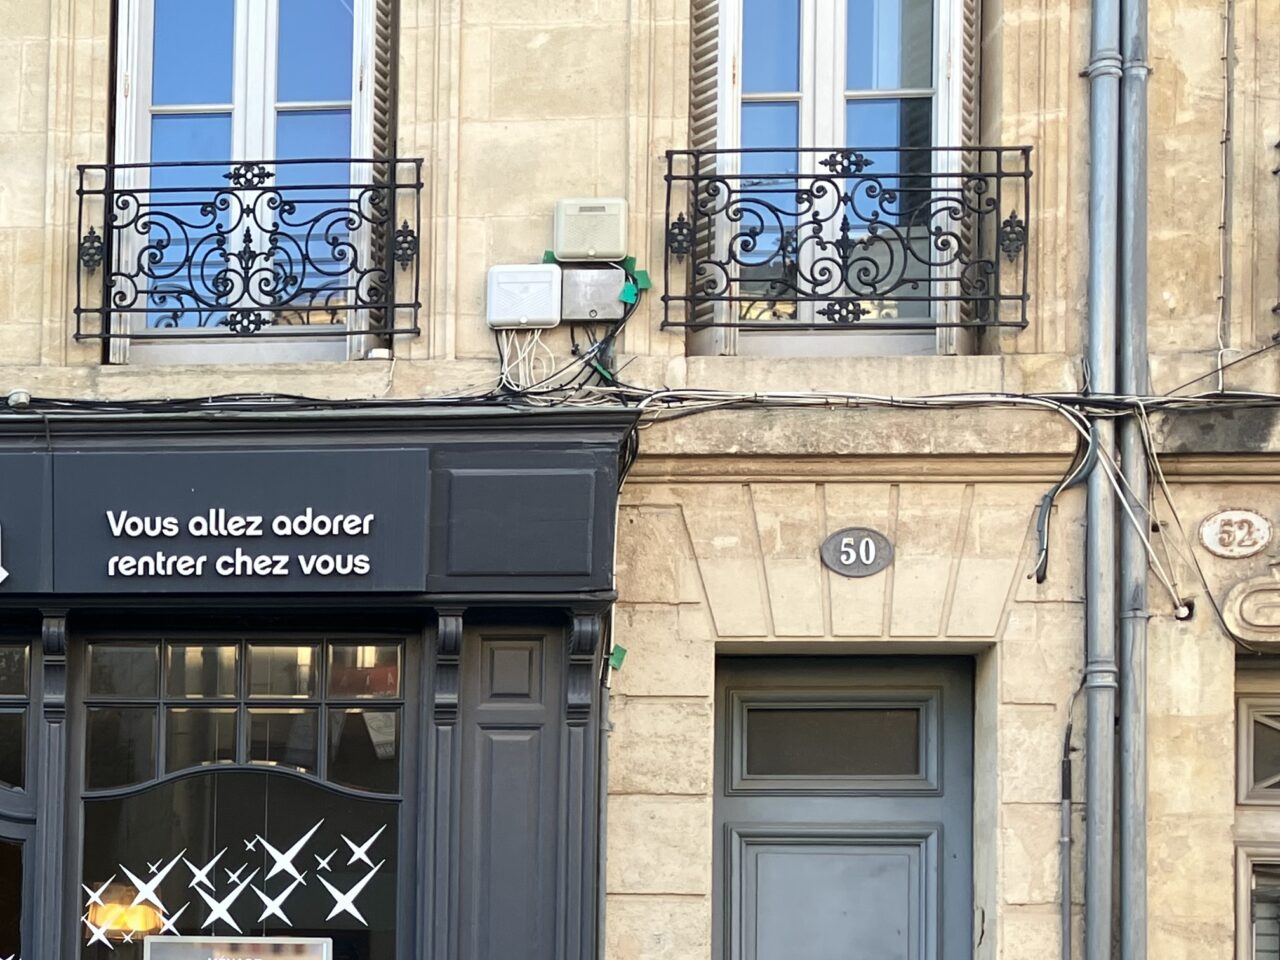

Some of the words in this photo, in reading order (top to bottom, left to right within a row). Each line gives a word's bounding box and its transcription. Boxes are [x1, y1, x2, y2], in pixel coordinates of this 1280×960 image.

[106, 510, 179, 537] Vous
[188, 508, 263, 537] allez
[272, 507, 375, 536] adorer
[1218, 518, 1258, 548] 52
[108, 551, 207, 576] rentrer
[215, 547, 290, 576] chez
[298, 554, 371, 576] vous
[840, 537, 876, 565] 50
